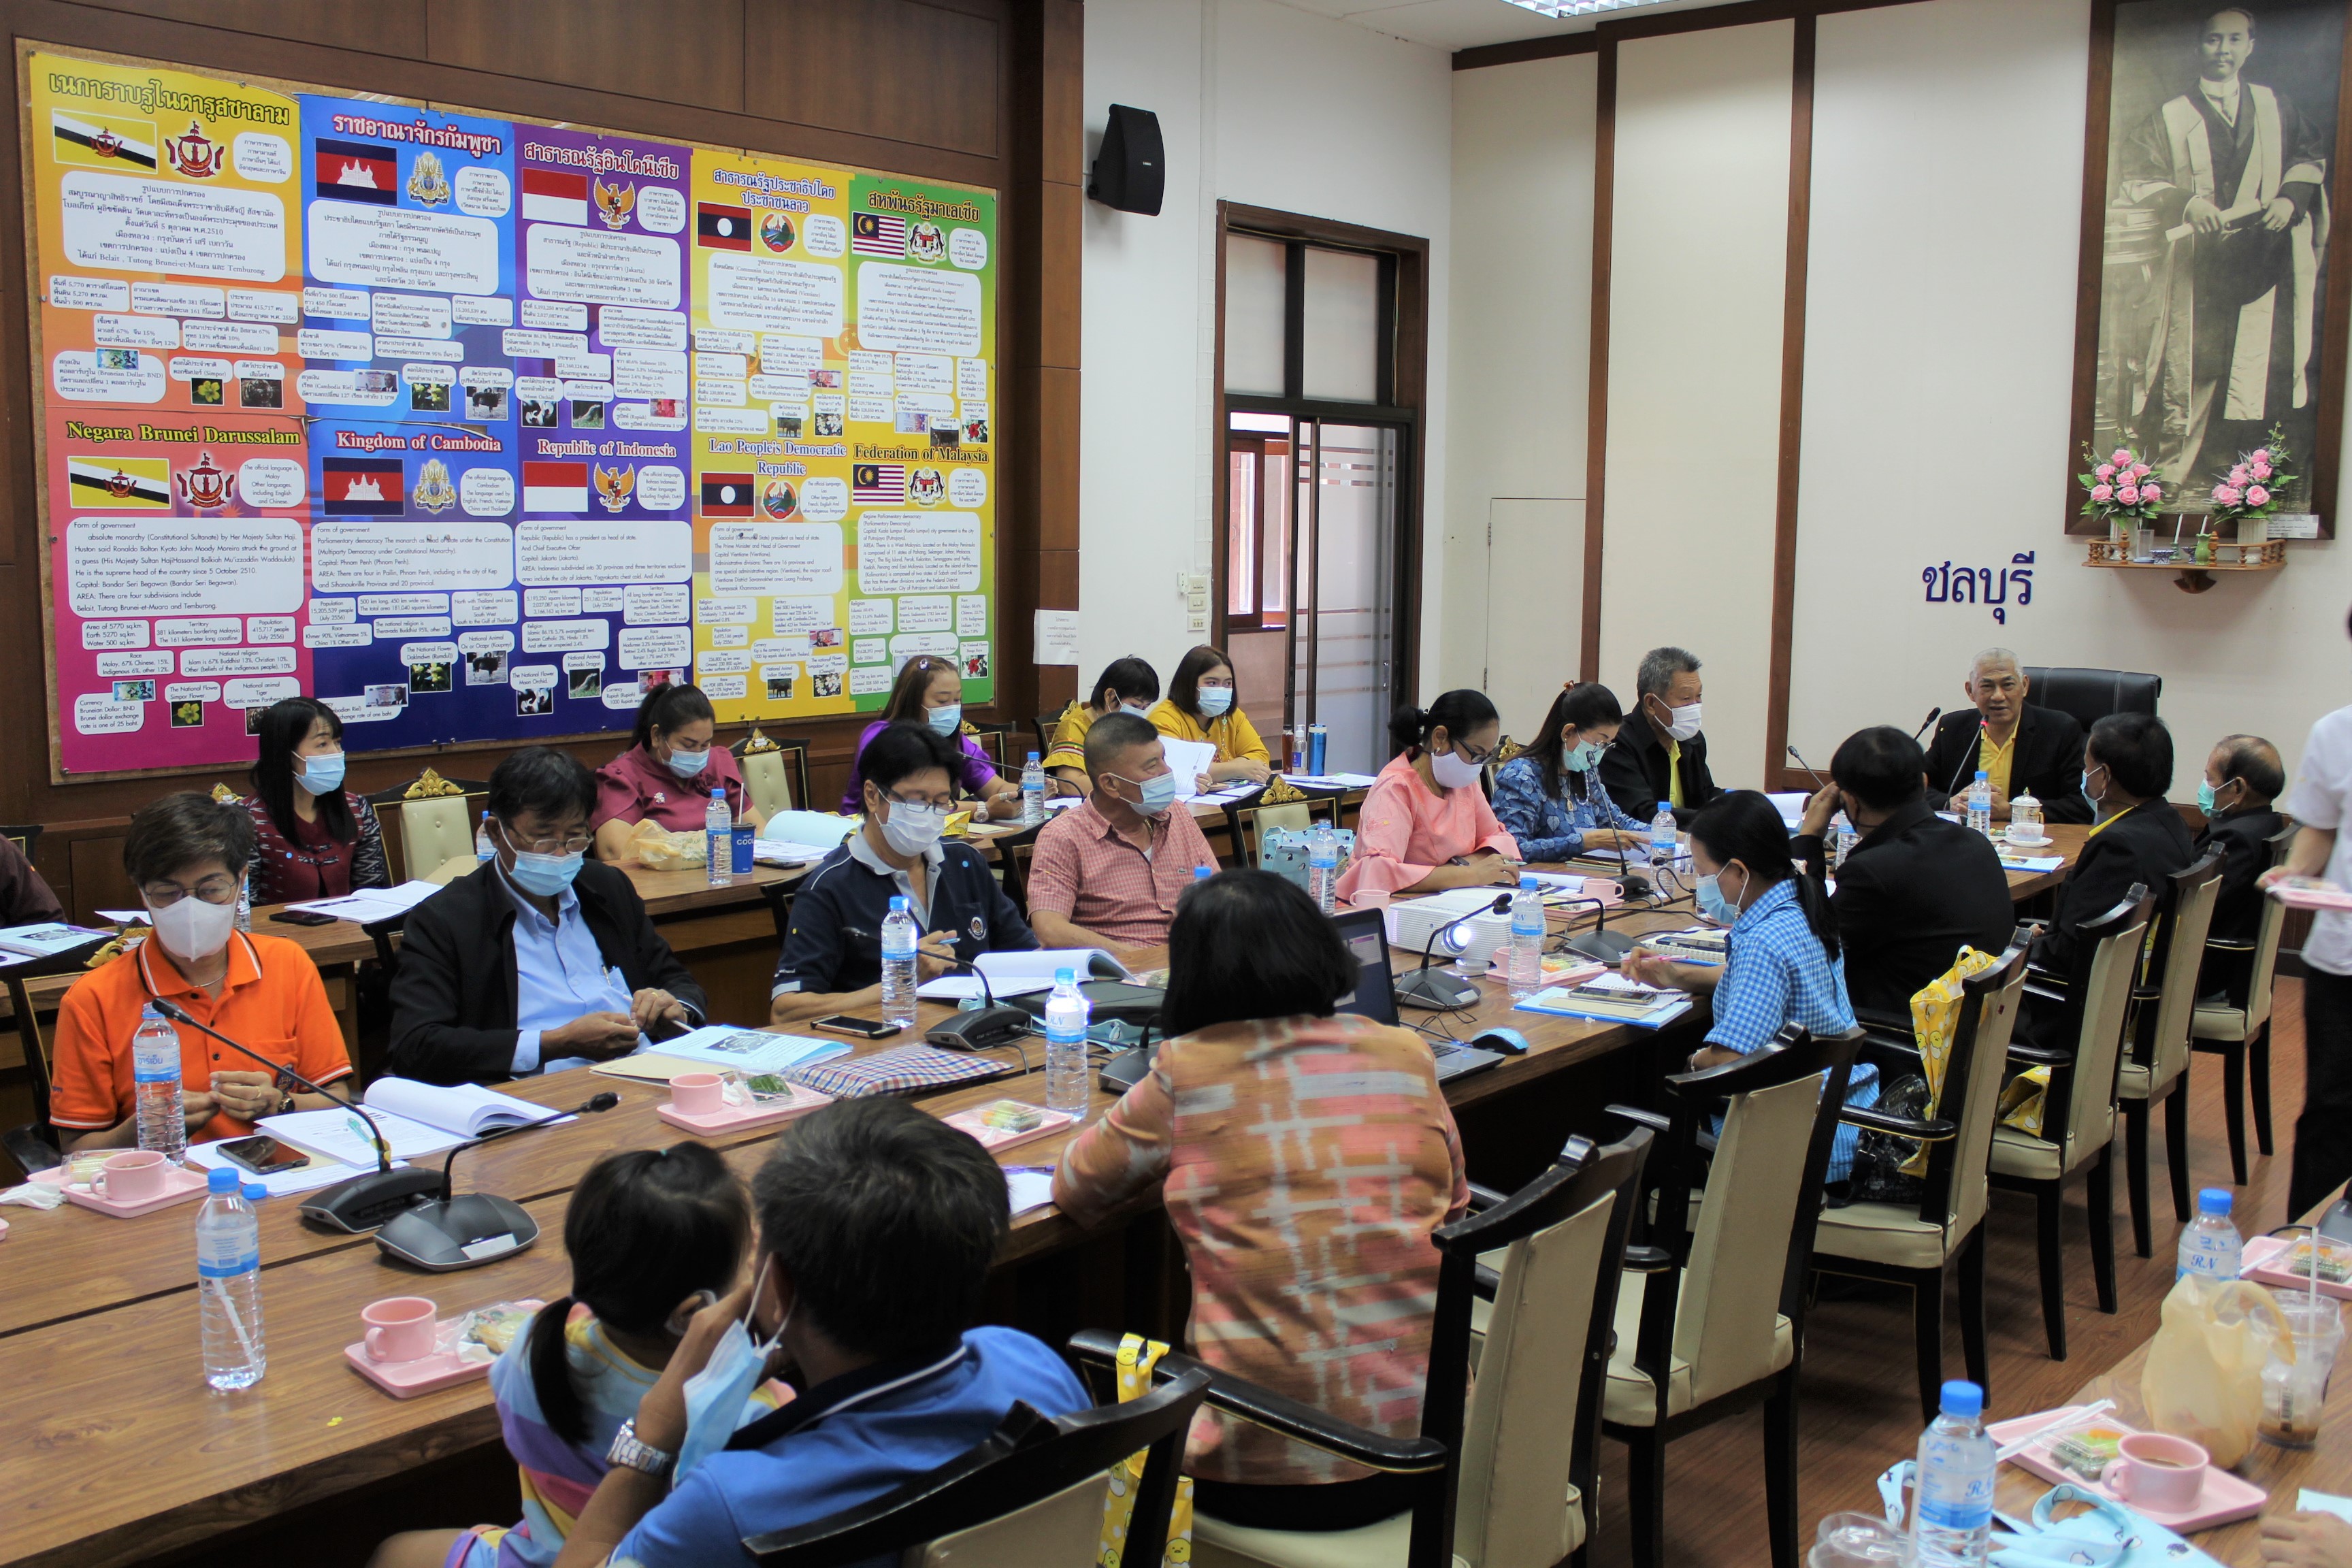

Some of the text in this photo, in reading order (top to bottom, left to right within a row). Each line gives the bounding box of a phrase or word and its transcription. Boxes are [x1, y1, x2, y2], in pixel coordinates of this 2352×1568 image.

[50, 72, 289, 125] เนการาบรูไนดารุสซาลาม
[332, 112, 502, 157] ราชอาณาจักรกัมพูชา
[524, 142, 679, 180] สาธารณรัฐอินโดนีเซีย
[713, 168, 835, 199] สาธารณรัฐประชาธิปไตย
[741, 191, 810, 213] ประชาชนลาว
[868, 190, 980, 223] สหพันธรัฐมาเลเซีย
[67, 422, 300, 444] Negara Brunei Darussalam
[336, 431, 502, 452] Kingdom of Cambodia
[538, 439, 677, 458] Republic of Indonesia
[709, 439, 847, 457] Lao People's Democratic
[854, 444, 989, 466] Federation of Malaysia
[757, 461, 806, 477] Republic
[115, 533, 145, 542] monarchy
[220, 533, 228, 541] by
[318, 548, 346, 556] (Multiparty
[318, 559, 338, 567] Capital:
[76, 580, 100, 589] Capital:
[140, 580, 168, 588] Begawan
[1922, 551, 2035, 625] ชลบุรี
[2191, 1254, 2218, 1270] RN
